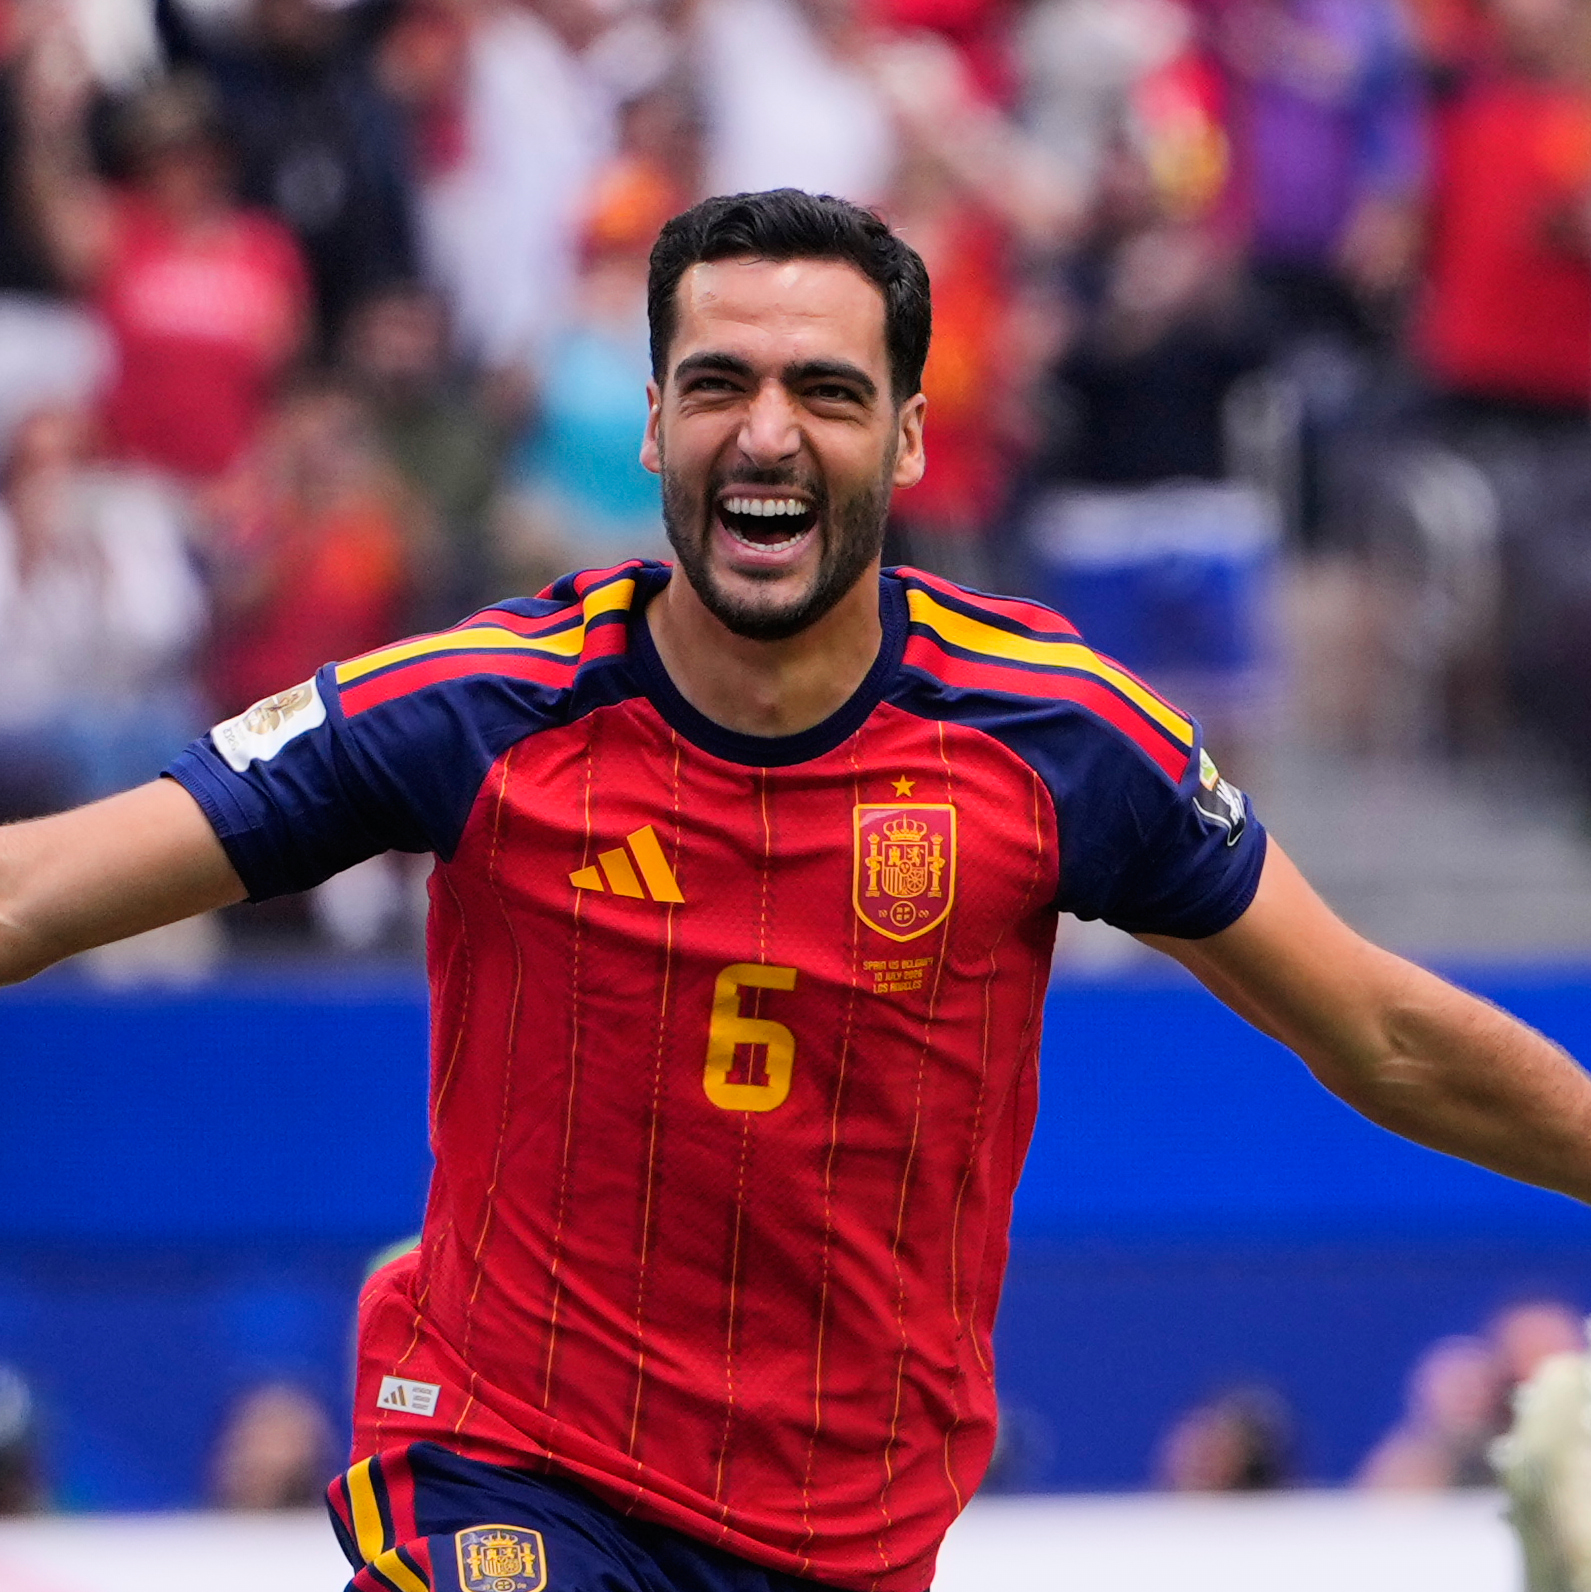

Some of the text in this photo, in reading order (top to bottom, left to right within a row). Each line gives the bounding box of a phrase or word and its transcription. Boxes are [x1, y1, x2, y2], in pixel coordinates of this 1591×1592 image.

[885, 970, 902, 981] JULY
[873, 982, 889, 994] LOS
[703, 962, 798, 1112] 6
